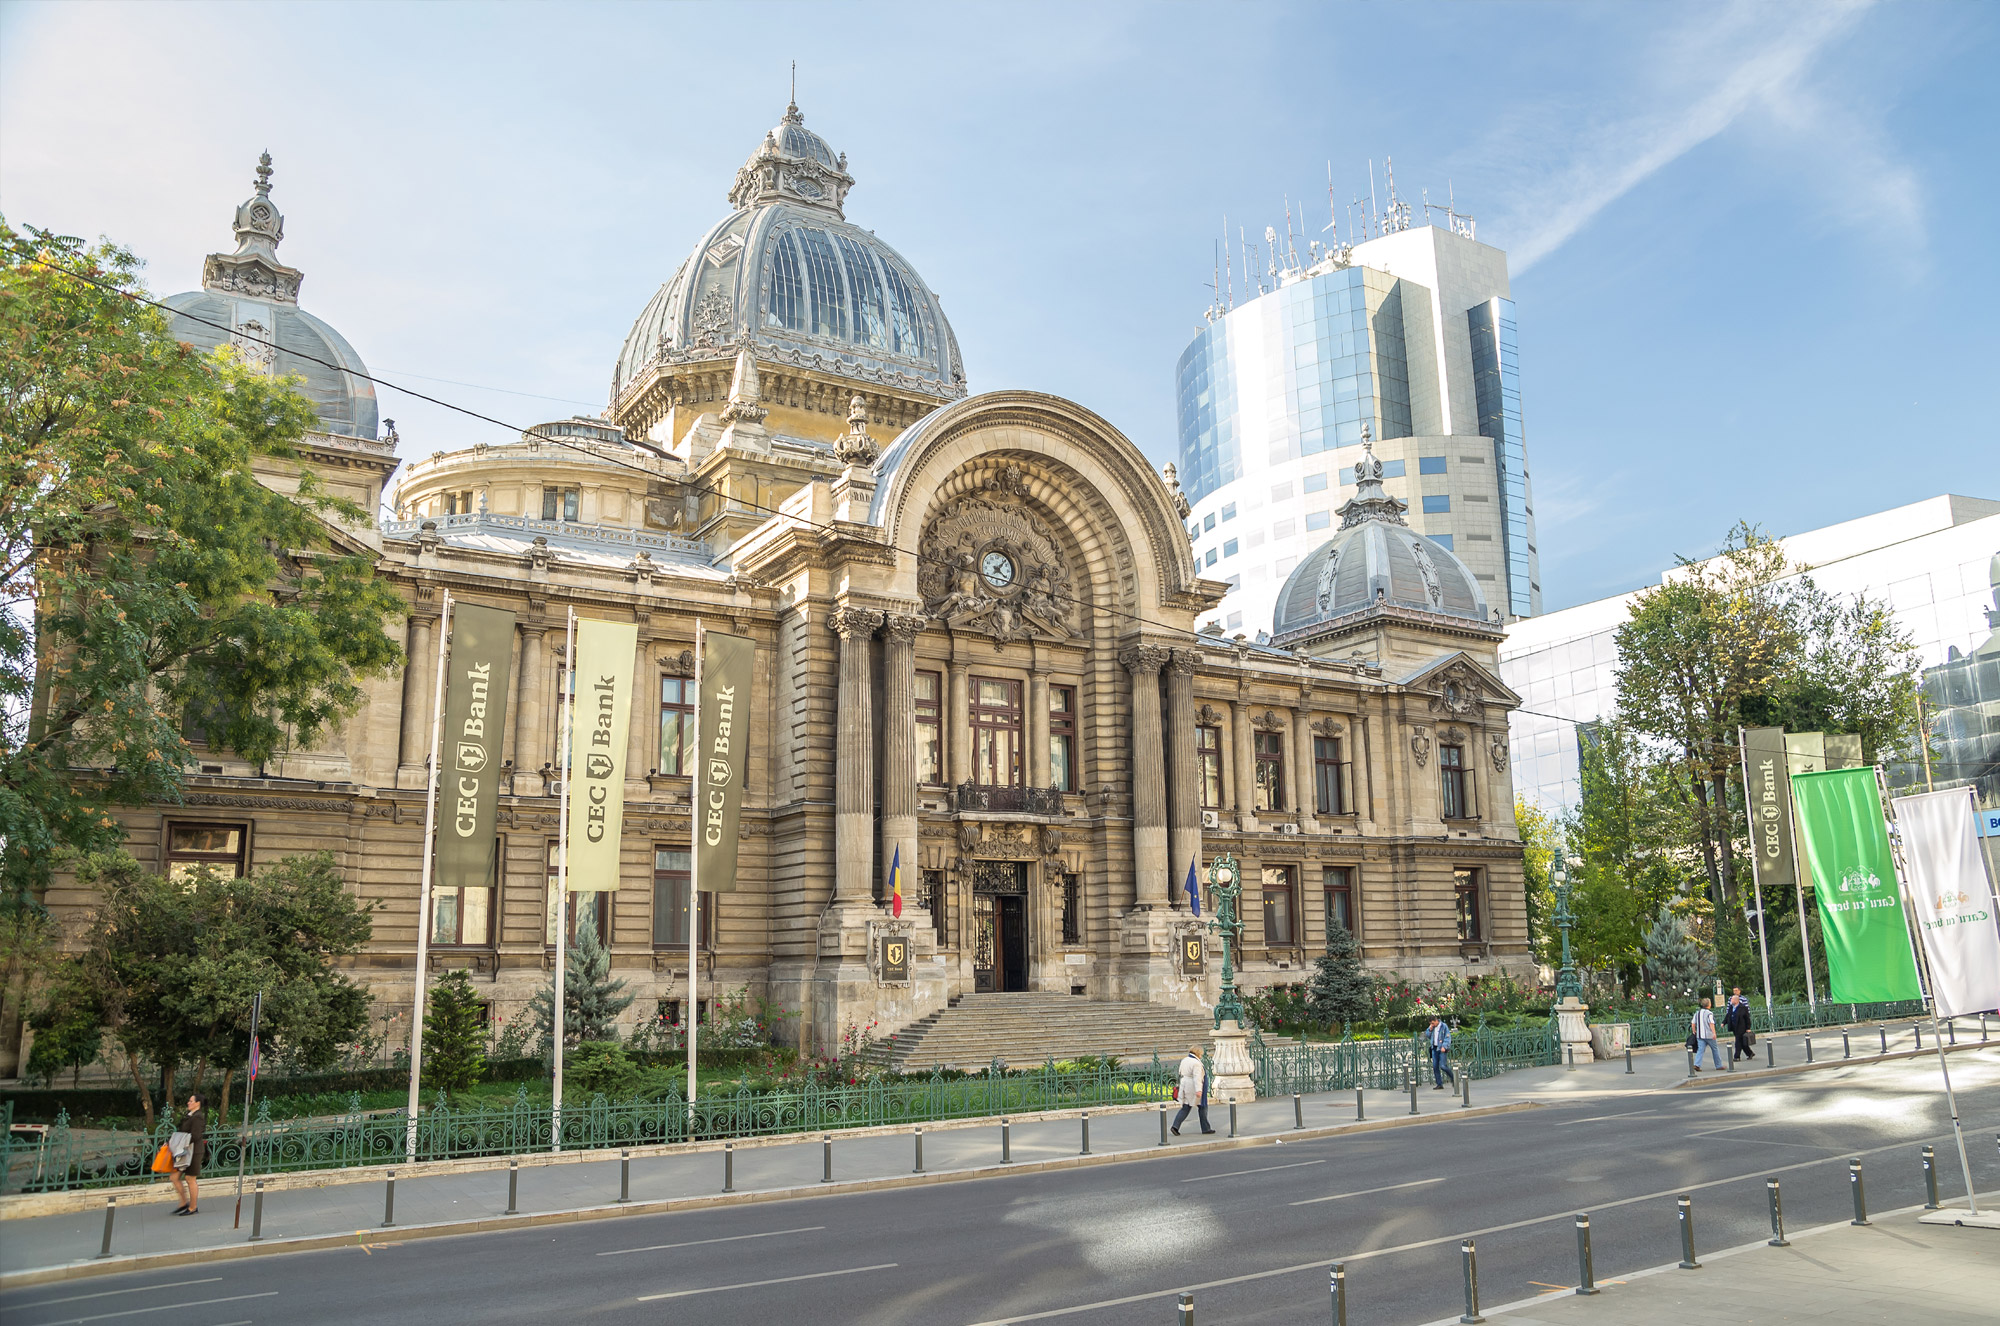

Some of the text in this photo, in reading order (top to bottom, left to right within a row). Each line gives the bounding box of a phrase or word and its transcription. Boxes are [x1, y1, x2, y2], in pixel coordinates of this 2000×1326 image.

[455, 661, 491, 838] CEC Bank
[587, 675, 616, 843] CEC Bank
[705, 684, 735, 847] CEC Bank
[1759, 758, 1780, 858] CEC Bank
